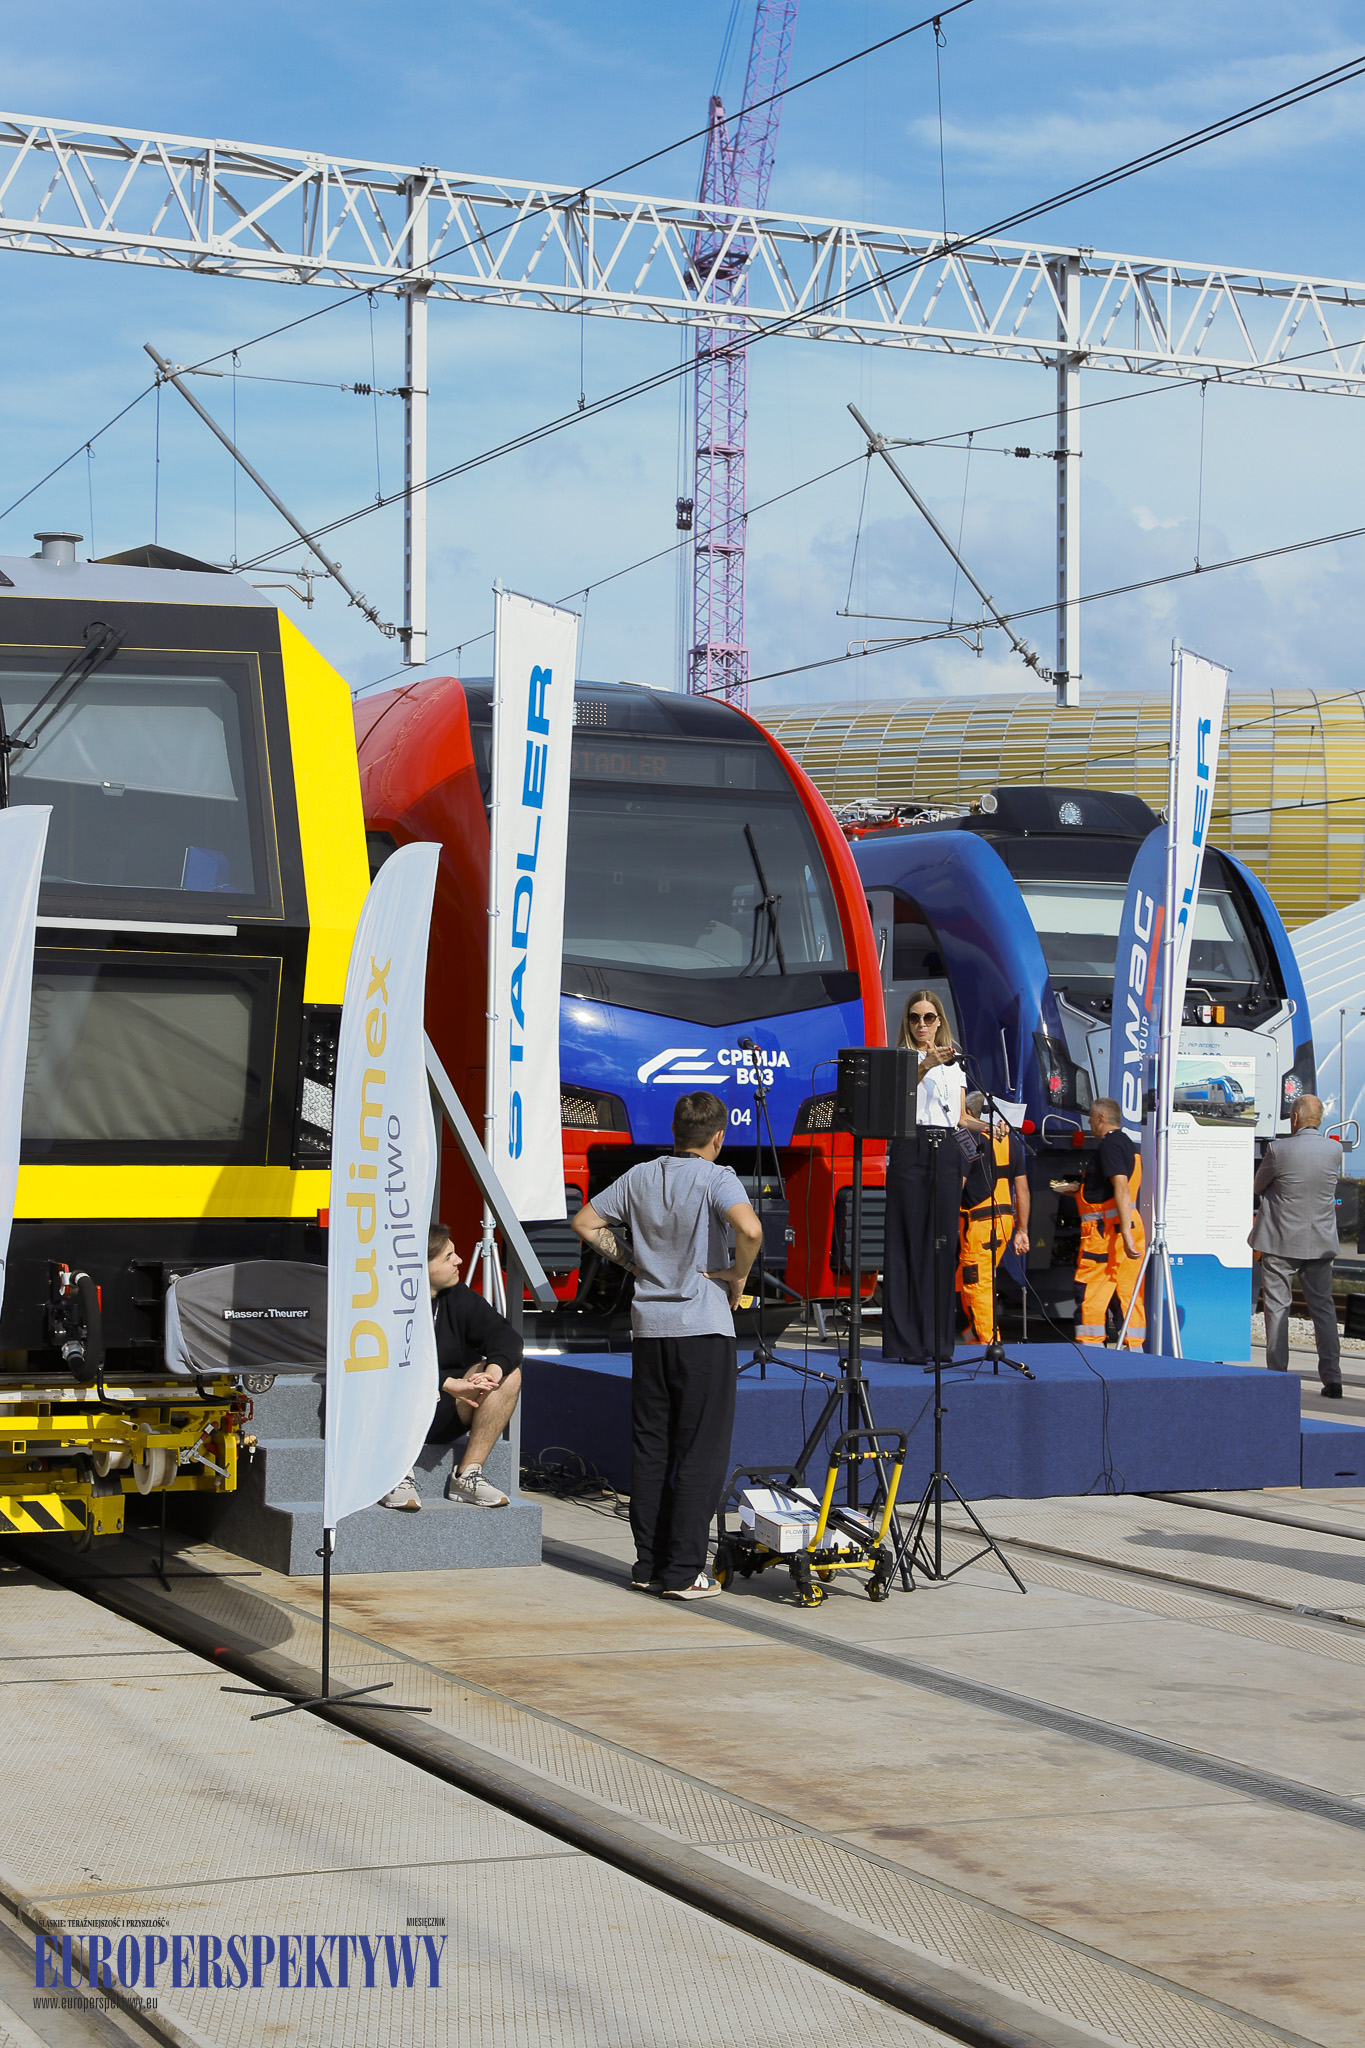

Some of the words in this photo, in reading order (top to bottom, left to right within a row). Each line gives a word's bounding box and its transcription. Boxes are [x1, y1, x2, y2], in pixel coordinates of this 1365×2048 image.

[508, 664, 553, 1160] STADLER
[717, 1048, 791, 1068] СРБИЈА
[730, 1108, 752, 1126] 04
[736, 1067, 775, 1086] ВОЗ
[344, 954, 392, 1373] budimex
[384, 1113, 424, 1368] kolejnictwo
